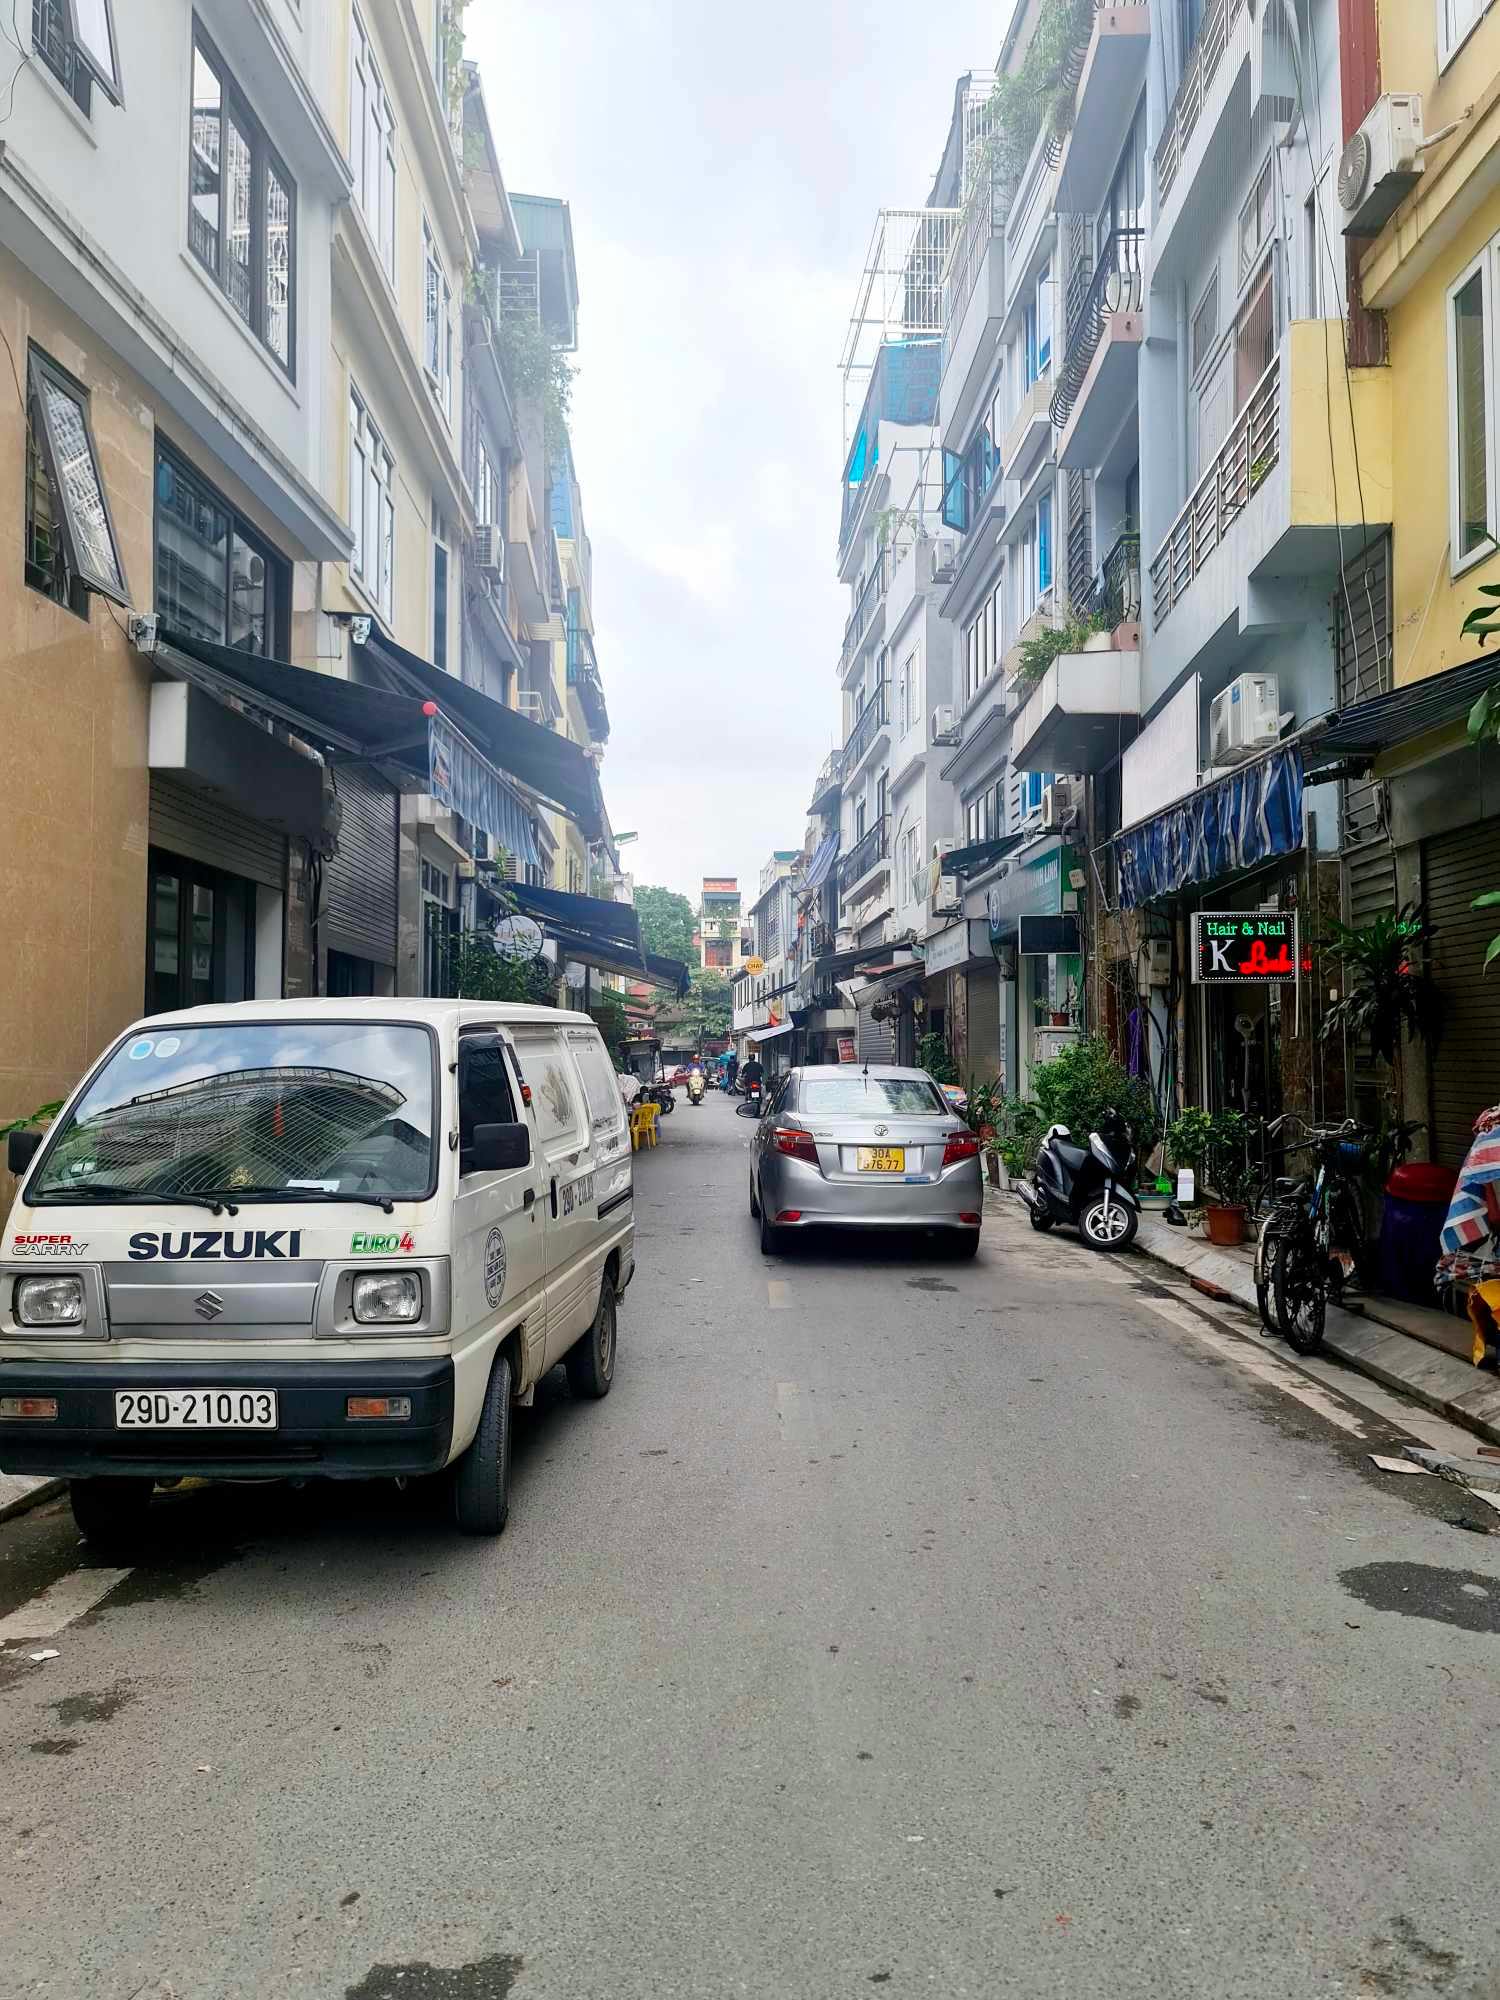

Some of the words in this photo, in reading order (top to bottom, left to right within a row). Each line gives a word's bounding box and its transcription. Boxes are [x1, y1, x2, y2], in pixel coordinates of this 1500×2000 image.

[1206, 921, 1238, 936] Hair
[1241, 921, 1254, 936] &
[1257, 920, 1286, 936] Nail
[1209, 939, 1237, 972] K
[871, 1148, 891, 1159] 30A
[14, 1235, 72, 1244] SUPER
[128, 1230, 301, 1261] SUZUKI
[12, 1243, 89, 1256] CARRY
[119, 1393, 272, 1424] 29D-210.03
